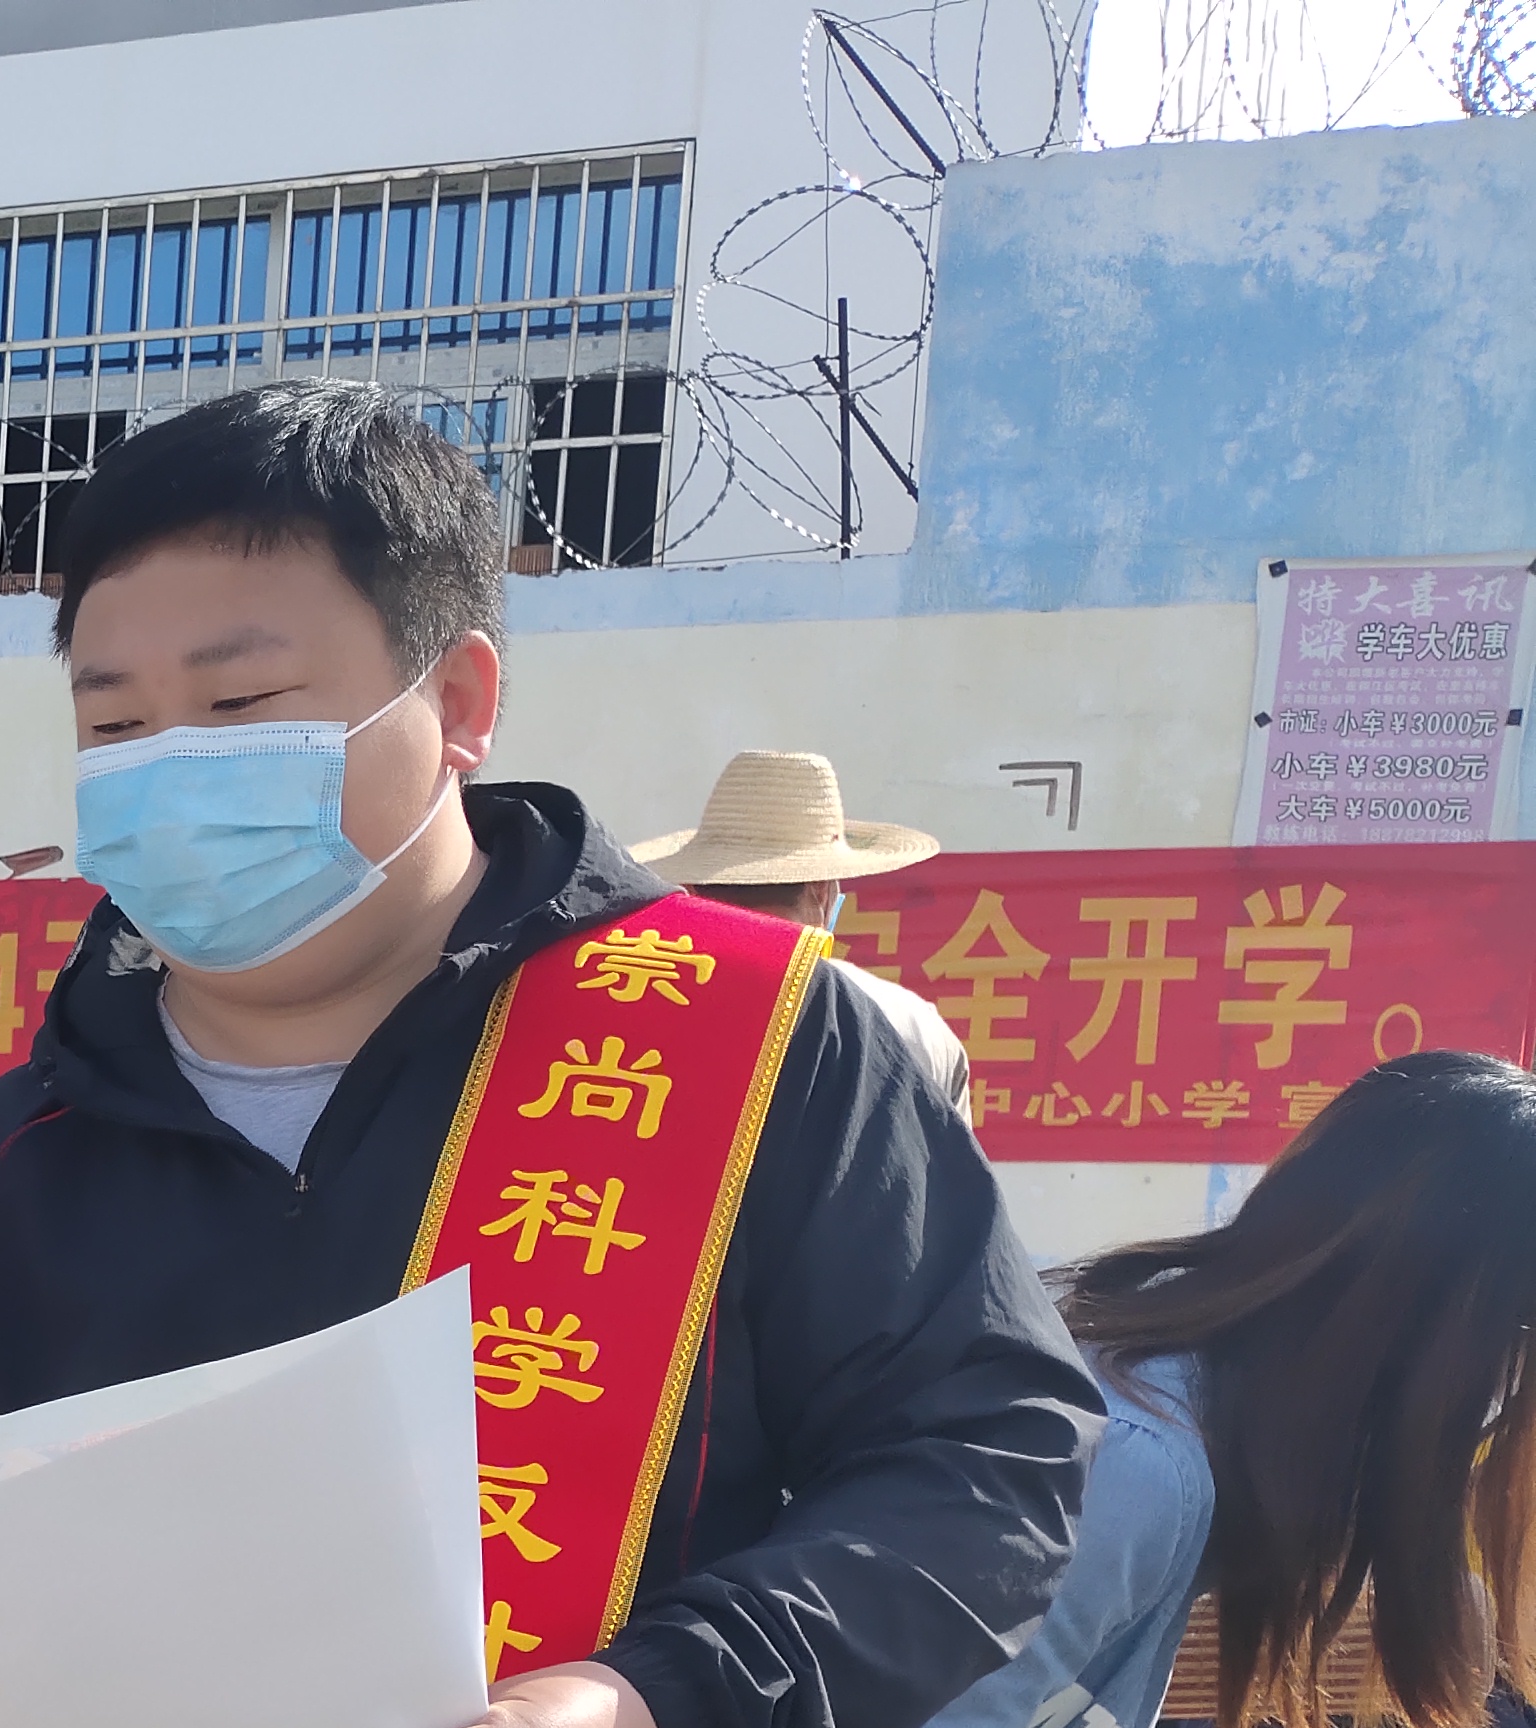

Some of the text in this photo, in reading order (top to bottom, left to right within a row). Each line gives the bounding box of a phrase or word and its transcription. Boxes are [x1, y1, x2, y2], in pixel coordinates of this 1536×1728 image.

[1297, 571, 1515, 619] 特大喜讯
[1356, 621, 1511, 661] 学车大优惠
